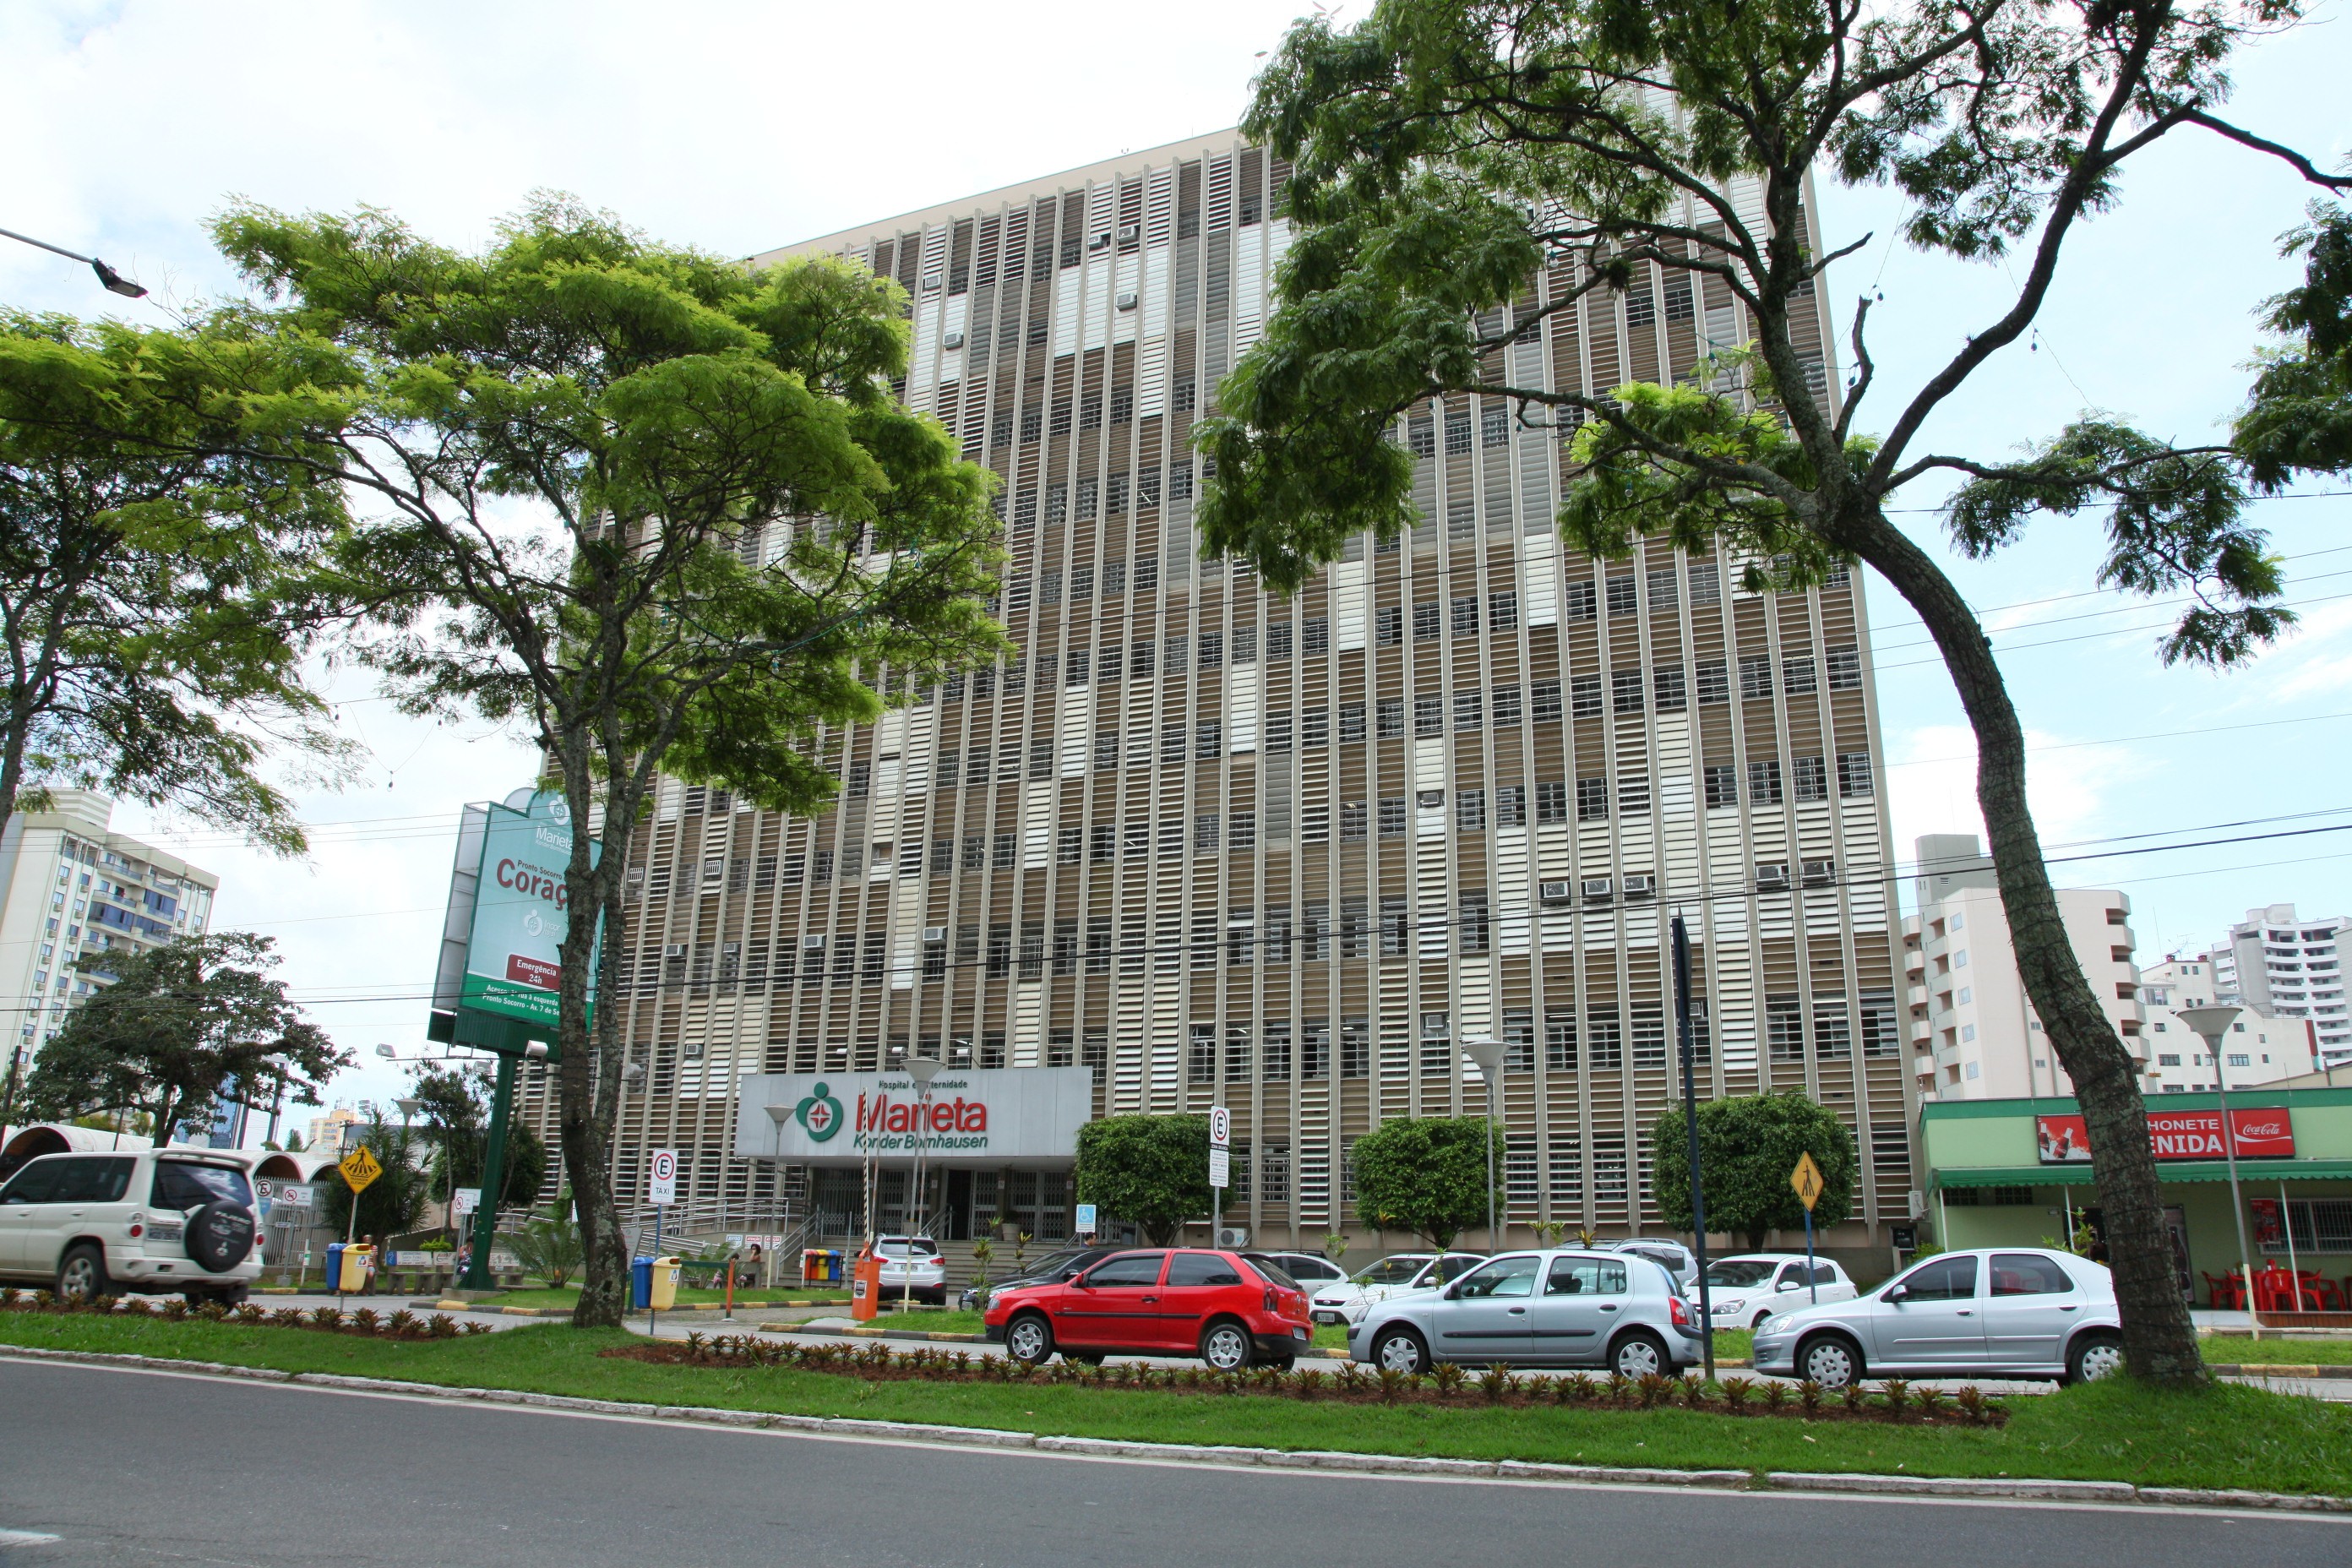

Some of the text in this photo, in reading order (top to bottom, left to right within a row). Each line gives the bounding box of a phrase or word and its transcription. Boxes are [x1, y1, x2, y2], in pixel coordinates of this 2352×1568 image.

[517, 859, 563, 880] Pronto Socorro
[497, 858, 568, 911] Coraç
[516, 959, 557, 977] Emergência
[528, 973, 542, 984] 24h
[482, 992, 502, 1003] Pronto
[503, 998, 525, 1009] Socorro
[530, 1004, 538, 1012] Av.
[545, 1006, 552, 1015] de
[533, 996, 558, 1006] esquerda
[879, 1080, 909, 1091] Hospital
[927, 1080, 968, 1089] ternidade
[855, 1094, 987, 1133] Marieta
[1217, 1116, 1223, 1135] E
[2242, 1123, 2280, 1135] Coca-Cola
[853, 1134, 904, 1149] Konder
[660, 1158, 669, 1175] E
